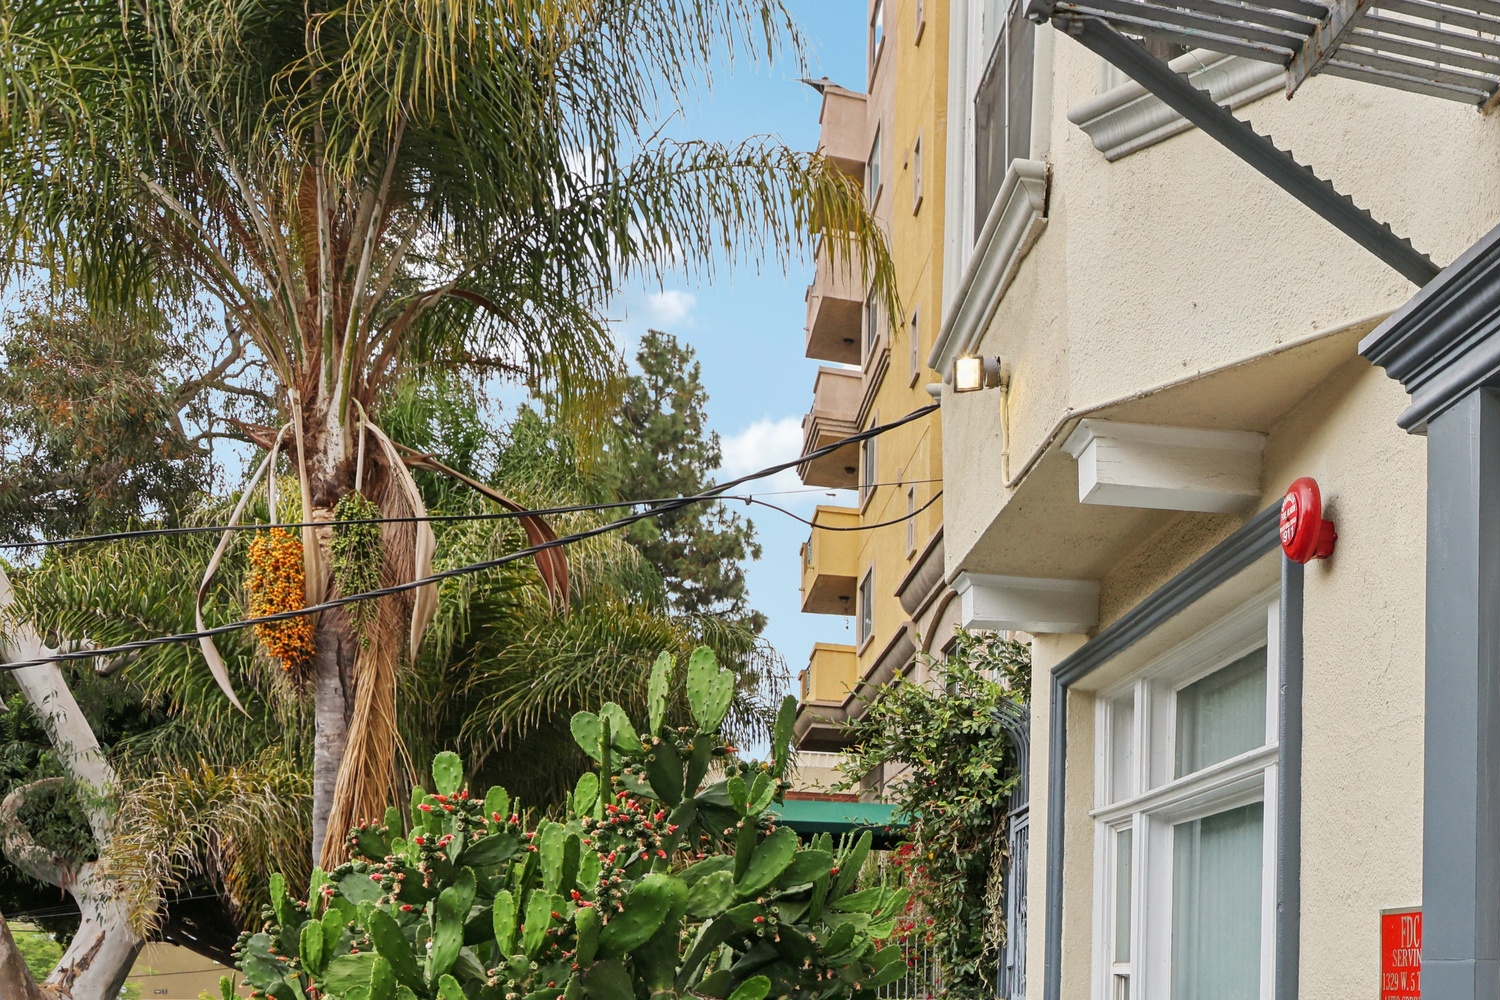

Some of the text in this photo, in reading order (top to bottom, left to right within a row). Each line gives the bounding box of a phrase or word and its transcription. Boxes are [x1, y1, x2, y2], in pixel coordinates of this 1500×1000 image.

[1401, 915, 1420, 948] FDC
[1383, 972, 1398, 991] 1329
[1401, 971, 1409, 991] W.
